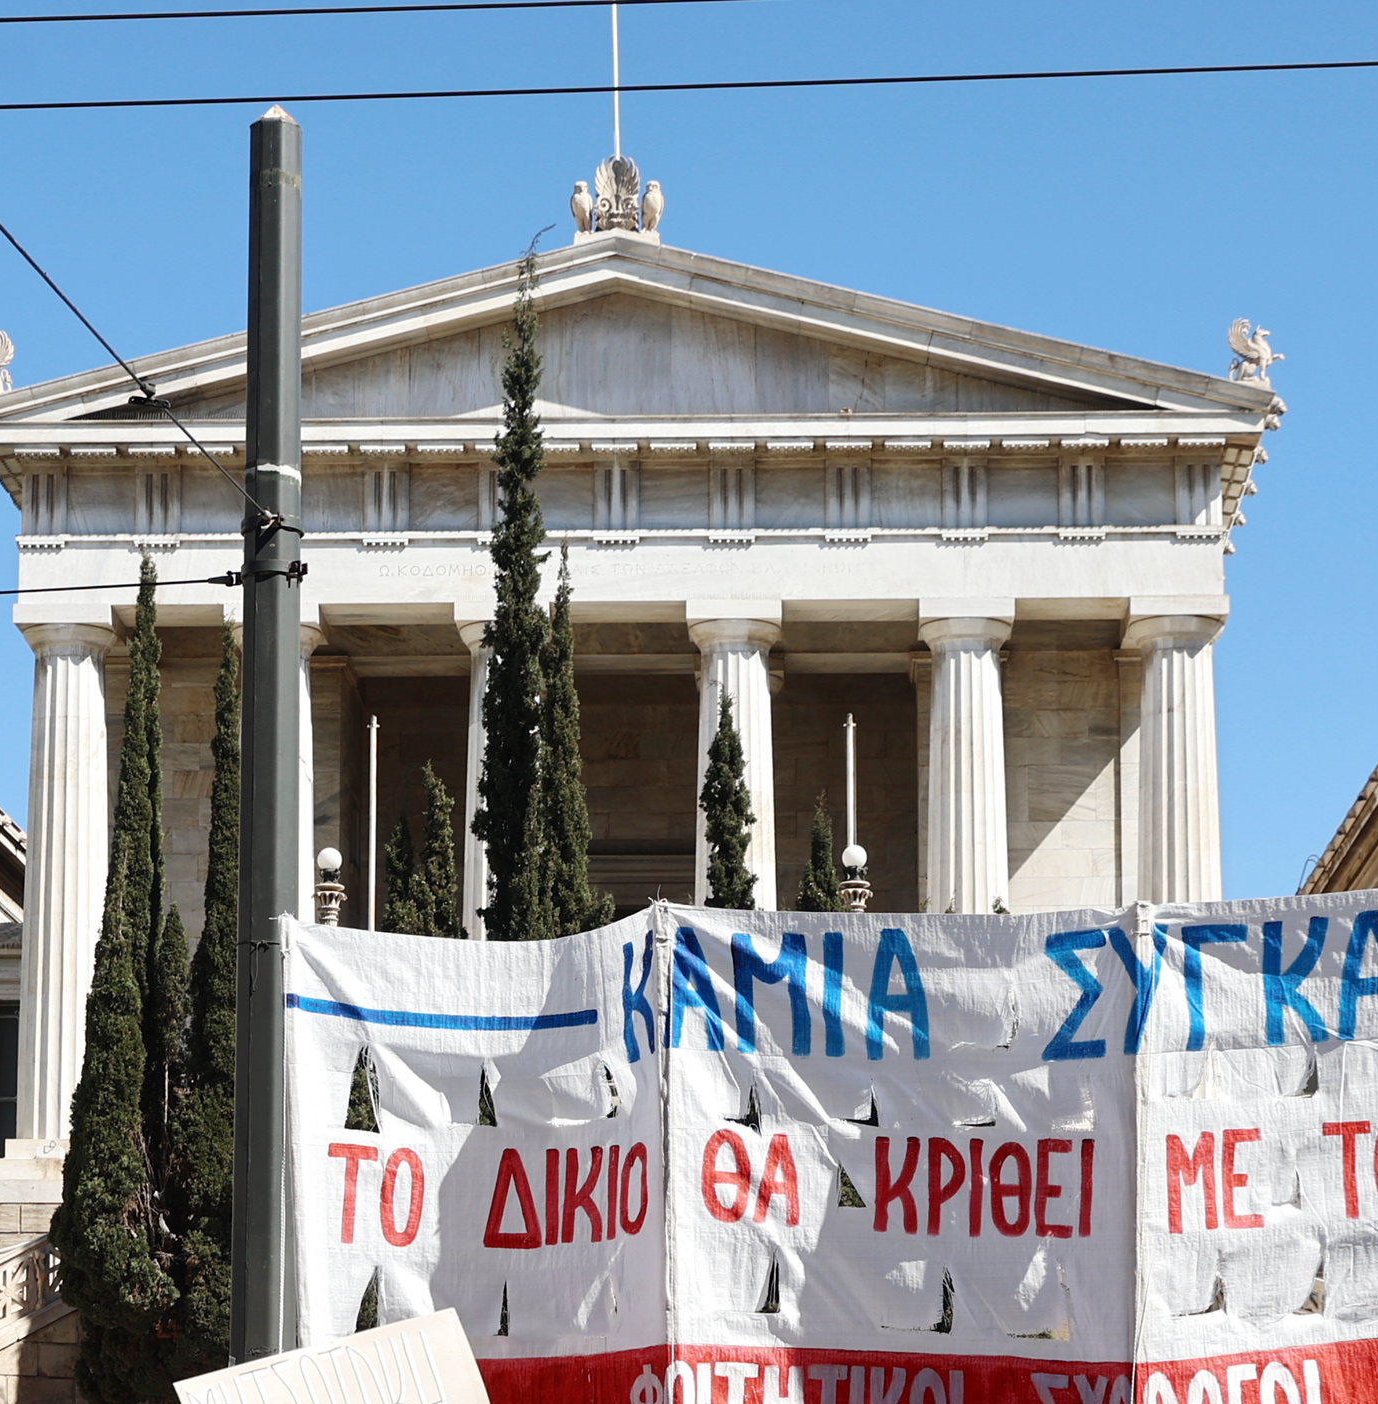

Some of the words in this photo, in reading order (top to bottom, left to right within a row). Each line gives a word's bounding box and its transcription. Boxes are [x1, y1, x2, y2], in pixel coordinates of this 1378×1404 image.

[623, 926, 930, 1063] ΚΑΜΙΑ
[328, 1143, 424, 1247] ΤΟ
[483, 1141, 648, 1250] ΔΙΚΙΟ
[702, 1129, 800, 1226] ΘΑ
[873, 1136, 1095, 1239] ΚΡΙΘΕΙ
[1167, 1128, 1265, 1234] ΜΕ
